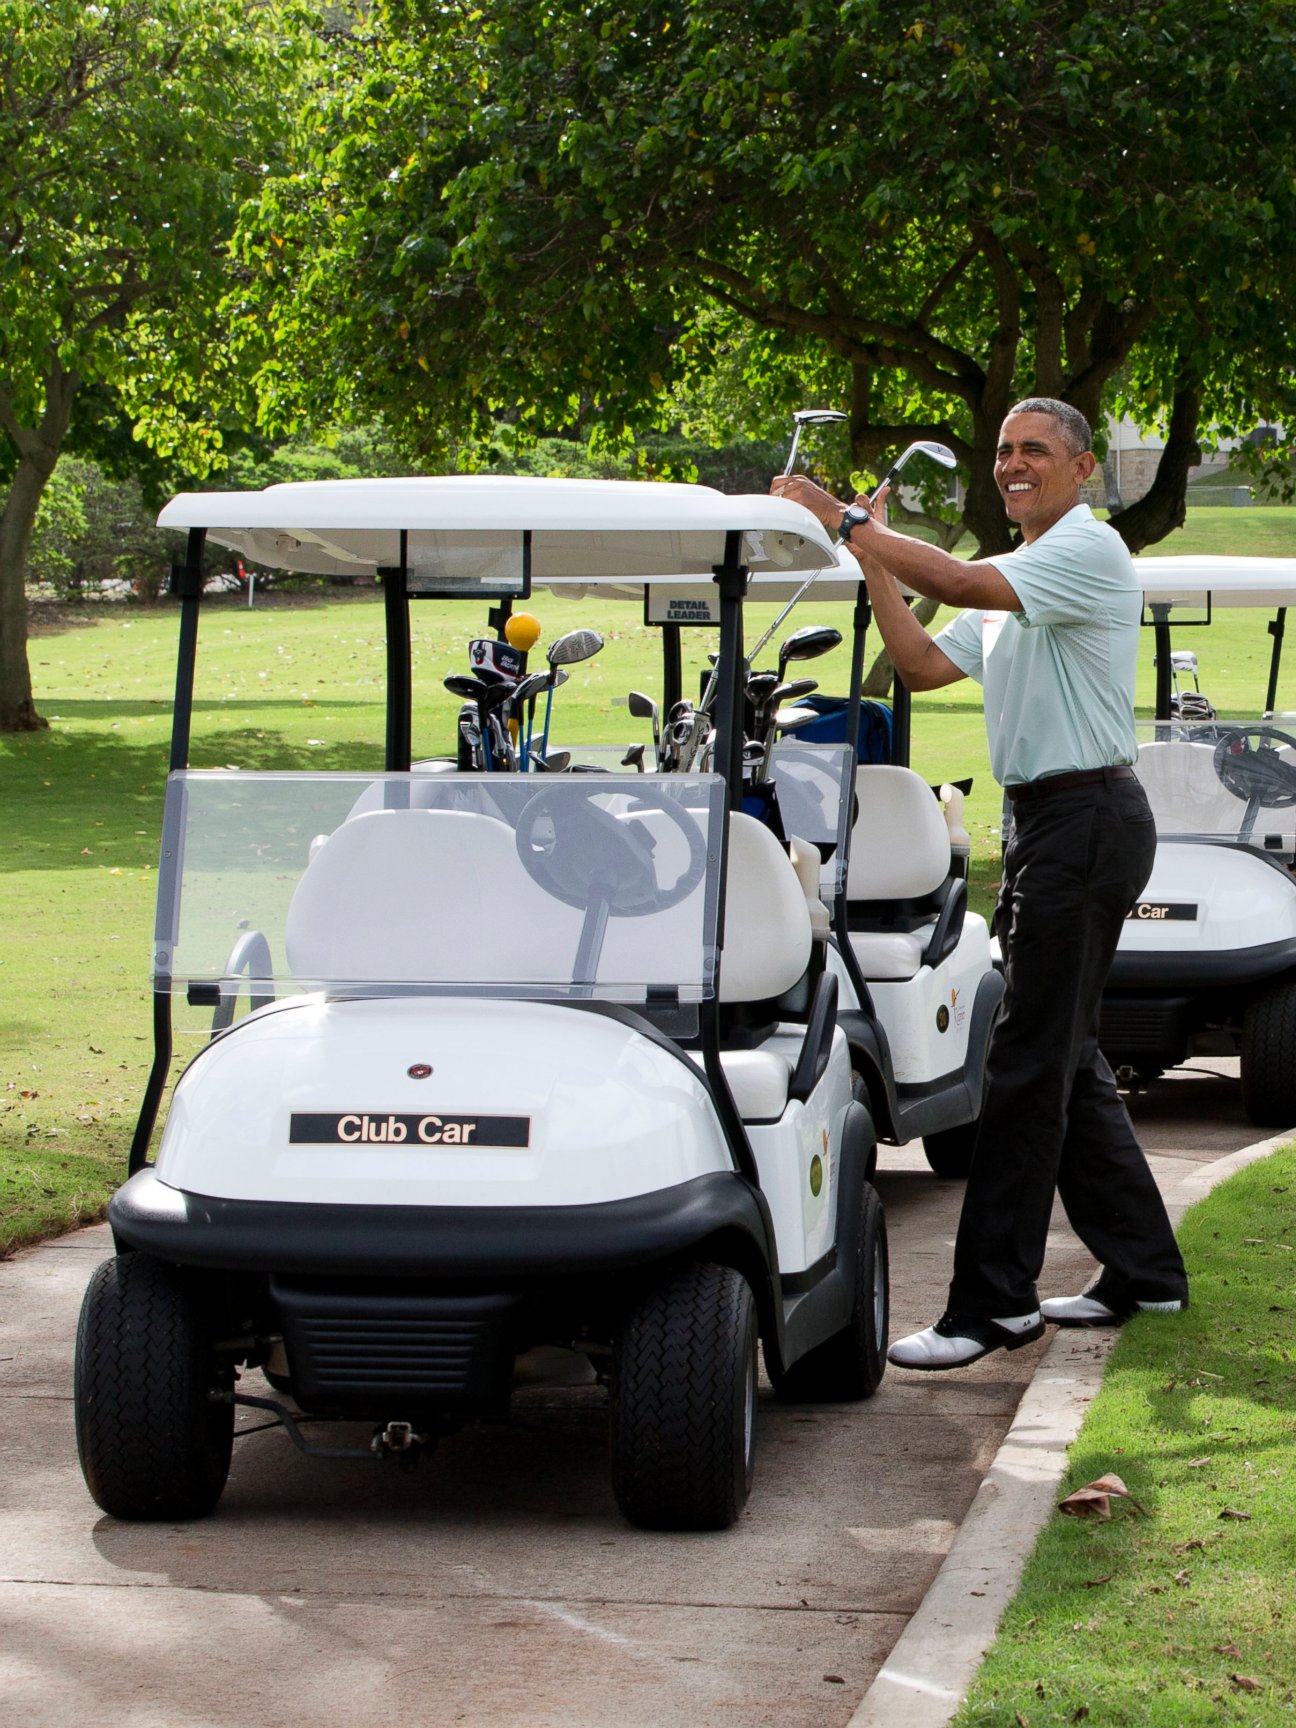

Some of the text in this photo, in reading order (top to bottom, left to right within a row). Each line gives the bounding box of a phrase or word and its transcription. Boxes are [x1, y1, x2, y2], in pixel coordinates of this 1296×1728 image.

[669, 600, 709, 610] DETAIL
[667, 610, 711, 620] LEADER
[1137, 903, 1169, 919] Car
[337, 1114, 476, 1144] Club Car
